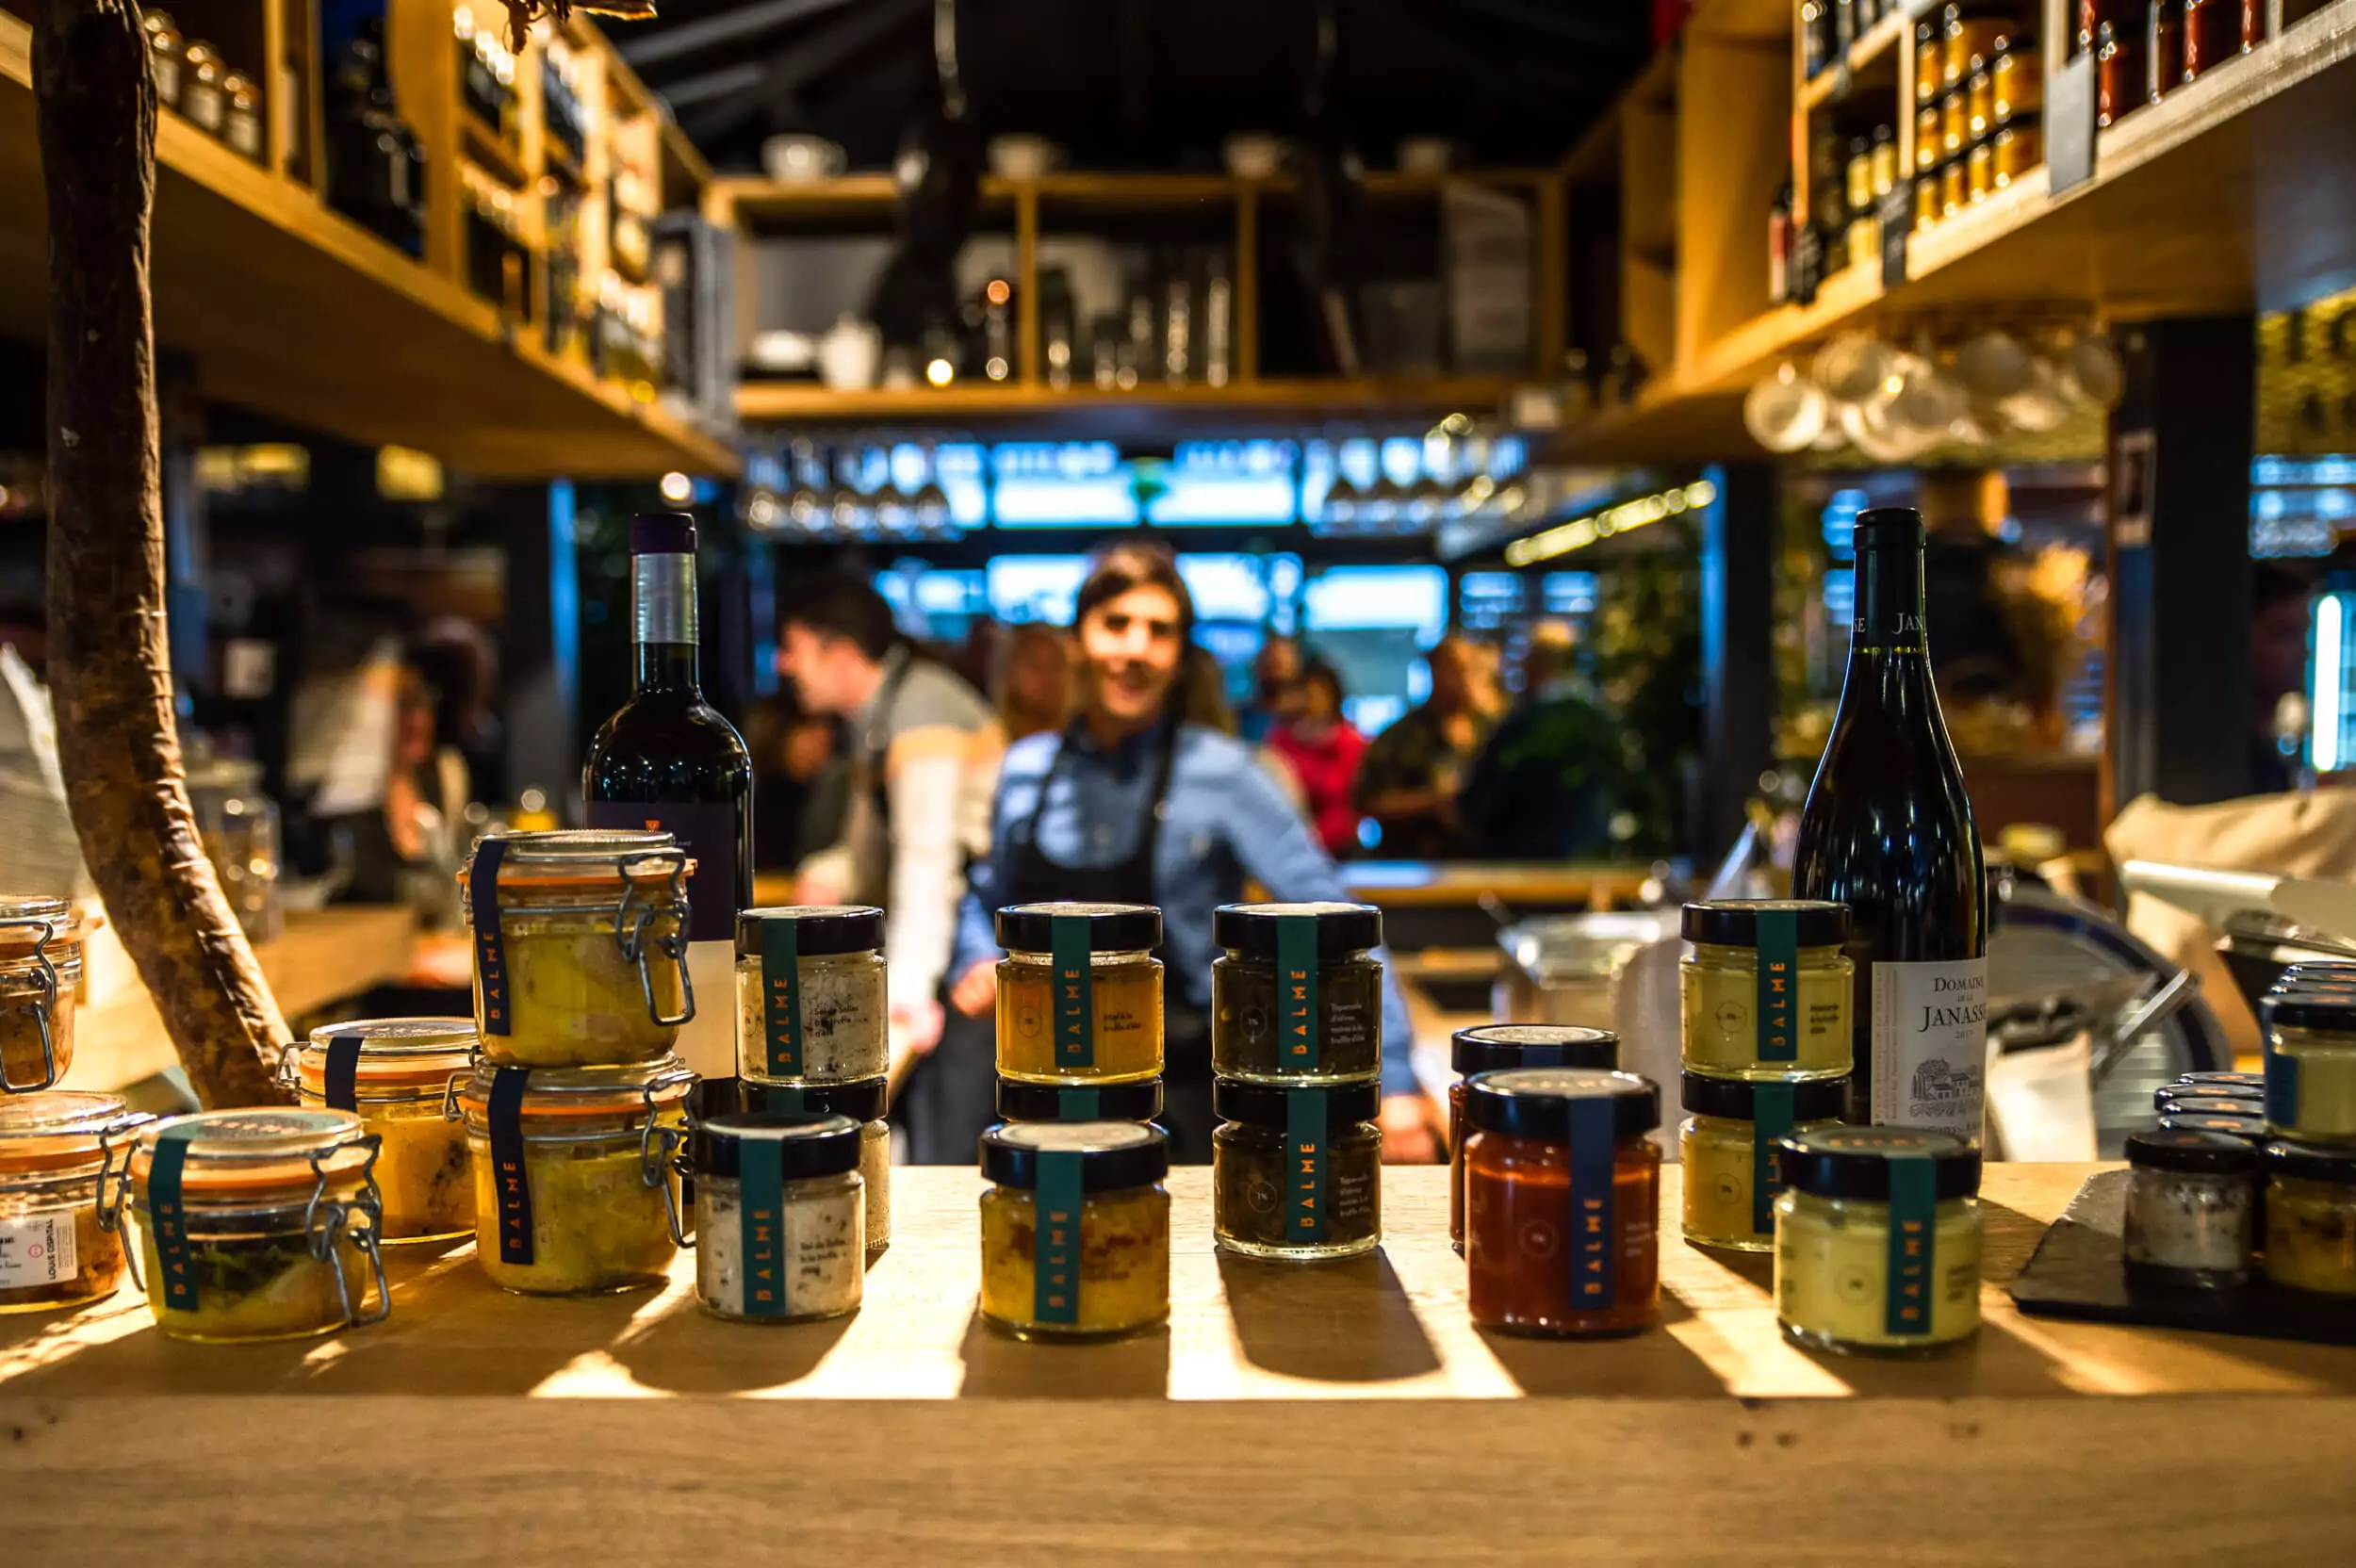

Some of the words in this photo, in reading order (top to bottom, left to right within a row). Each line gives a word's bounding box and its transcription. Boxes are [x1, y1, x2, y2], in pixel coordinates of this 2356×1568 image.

[483, 930, 501, 1021] BALME
[1065, 969, 1082, 1054] BALME
[1290, 970, 1307, 1054] BALME
[1770, 962, 1786, 1047] BALME
[1933, 975, 1984, 992] DOMAIN
[774, 977, 792, 1063] BALME
[503, 1161, 522, 1250] BALME
[1300, 1143, 1316, 1227] BALME
[48, 1254, 57, 1279] LOUIS
[160, 1202, 187, 1296] BALME
[753, 1209, 773, 1301] BALME
[1048, 1211, 1069, 1308] BALME
[1583, 1198, 1603, 1295] BALME
[1901, 1219, 1922, 1321] BALME
